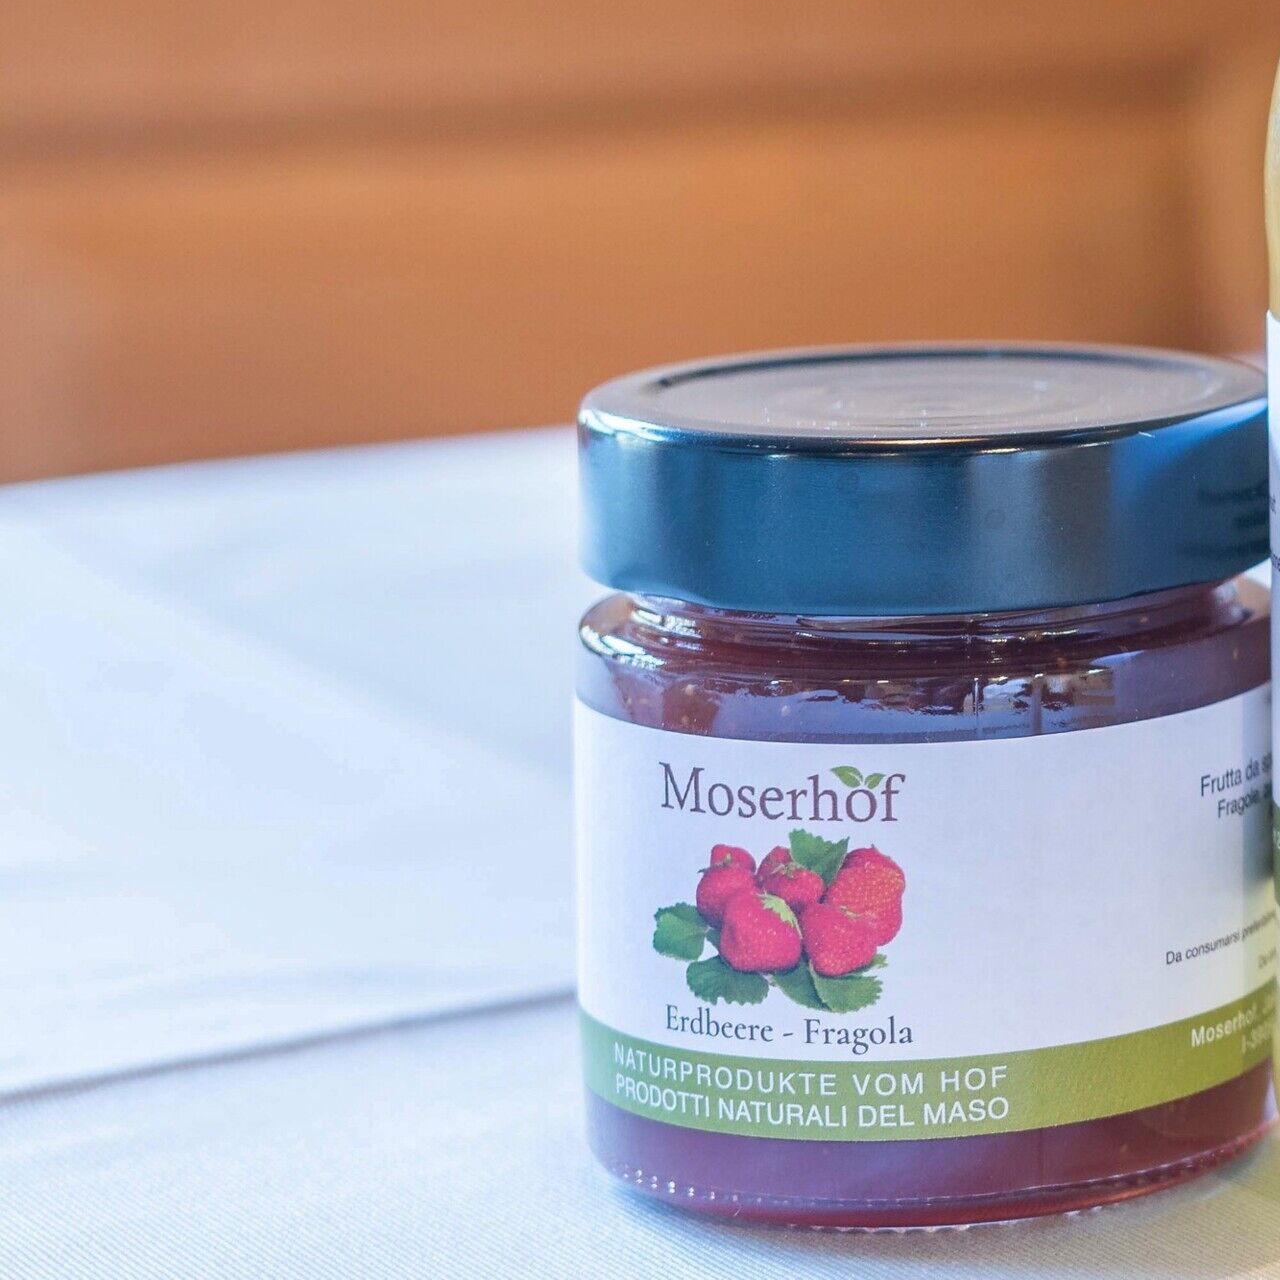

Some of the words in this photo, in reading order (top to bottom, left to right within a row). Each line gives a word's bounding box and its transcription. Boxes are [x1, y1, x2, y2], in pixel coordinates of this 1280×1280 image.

[658, 761, 906, 823] Moserhof
[1200, 767, 1242, 797] Frutta
[1165, 950, 1182, 965] Da
[665, 1004, 774, 1043] Erdbeere
[802, 1016, 913, 1055] Fragola
[613, 1042, 837, 1097] NATURPRODUKTE
[852, 1071, 924, 1097] VOM
[940, 1065, 1009, 1093] HOF
[615, 1073, 711, 1119] PRODOTTI
[718, 1100, 848, 1128] NATURALI
[858, 1104, 915, 1129] DEL
[923, 1096, 1010, 1123] MASO
